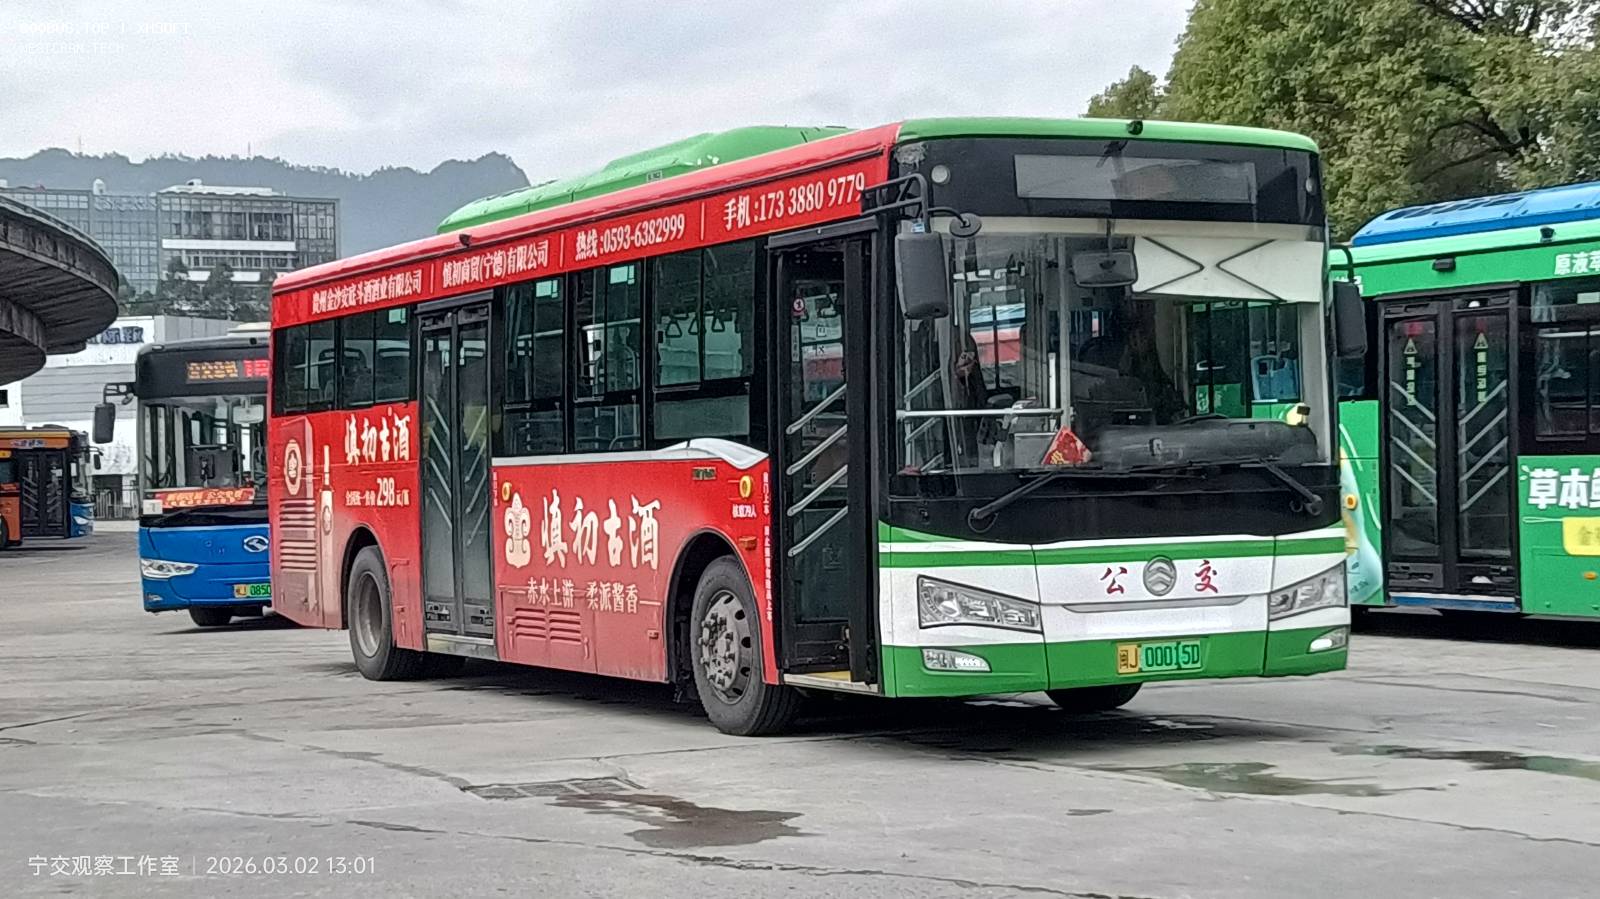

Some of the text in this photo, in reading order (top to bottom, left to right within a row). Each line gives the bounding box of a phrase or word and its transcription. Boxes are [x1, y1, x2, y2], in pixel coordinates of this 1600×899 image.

[788, 181, 824, 216] 3880
[827, 172, 865, 208] 9779
[541, 488, 662, 570] 慎初古酒
[527, 576, 640, 614] 赤水上游 柔派酱香
[1100, 560, 1219, 595] 公 交
[1144, 644, 1200, 668] 00015D
